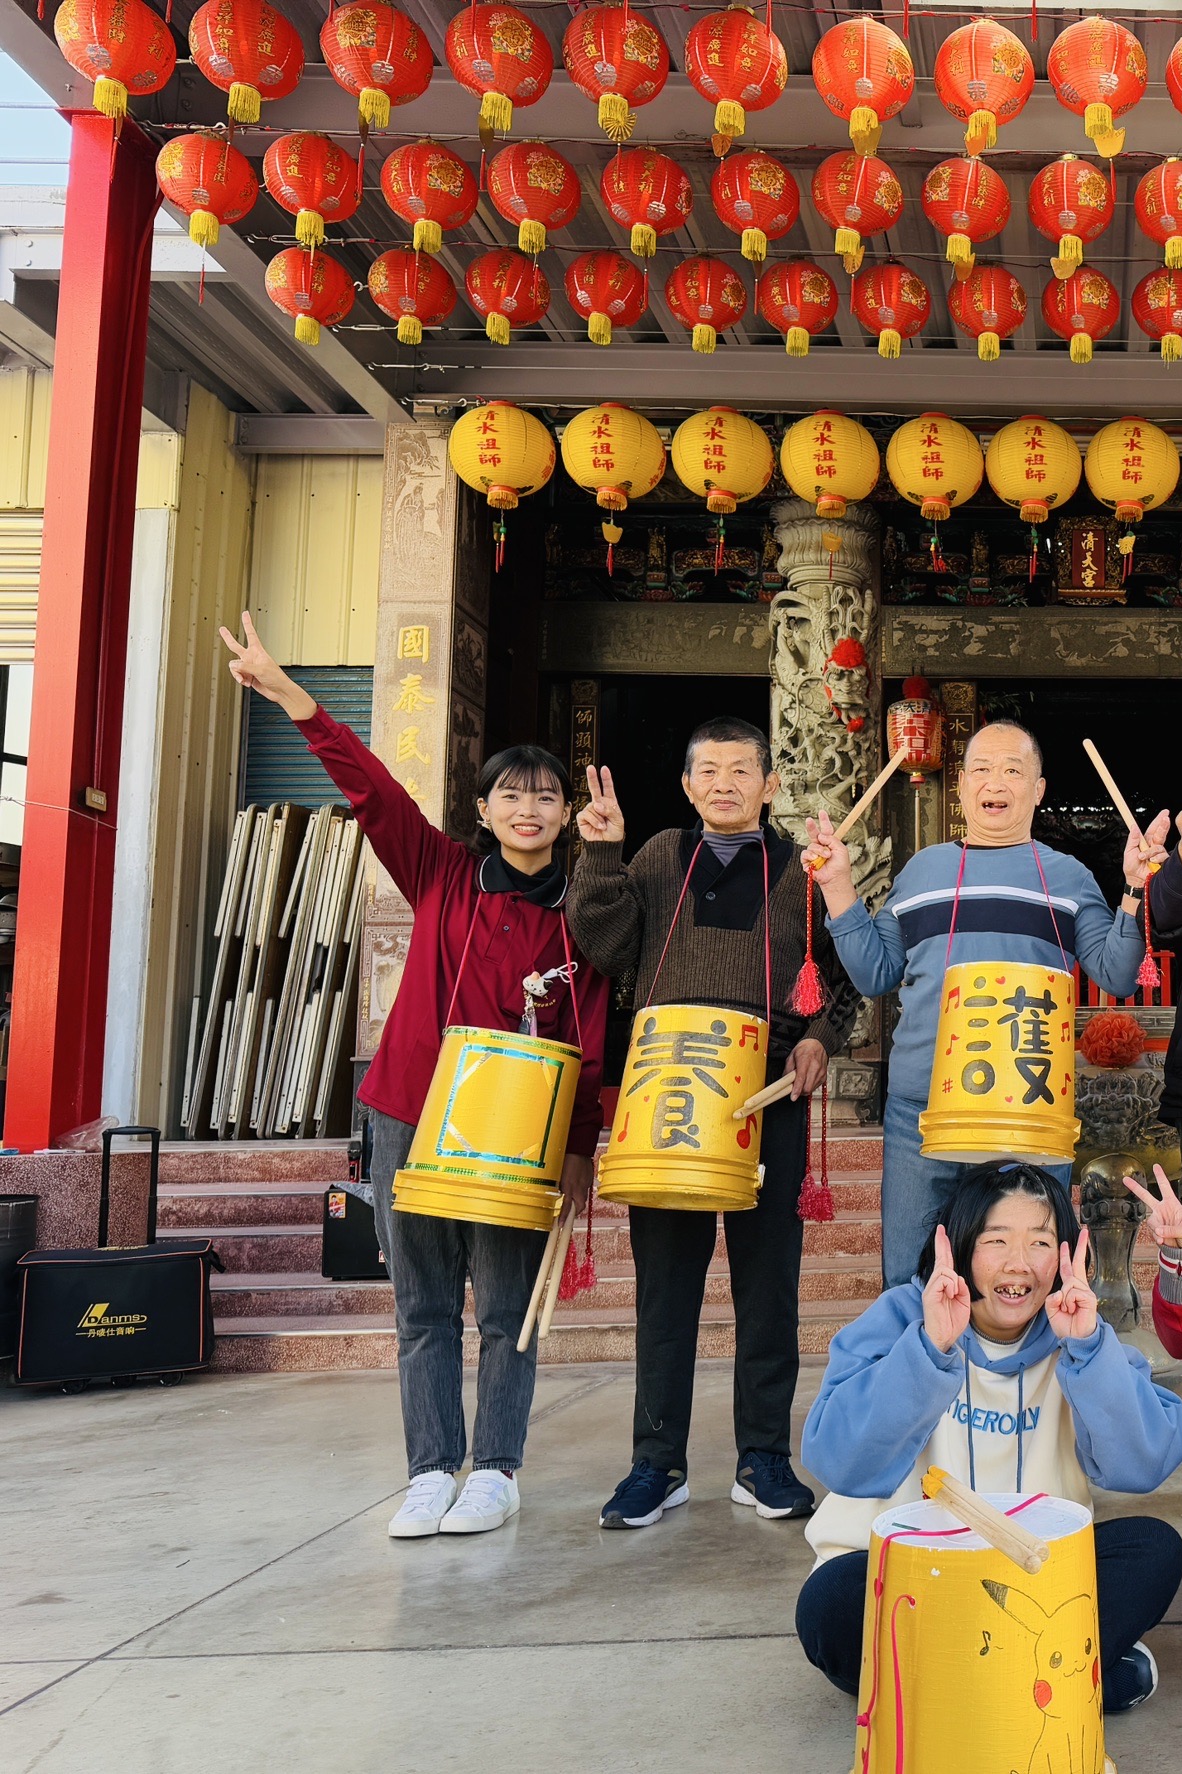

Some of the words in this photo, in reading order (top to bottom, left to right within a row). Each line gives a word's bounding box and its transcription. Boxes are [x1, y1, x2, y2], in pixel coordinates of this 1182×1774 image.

[475, 410, 502, 468] 清水祖師
[589, 413, 615, 472] 清水祖師
[702, 417, 727, 474] 清水祖師
[812, 421, 838, 478] 清水祖師
[919, 422, 945, 481] 清水祖師
[1024, 425, 1048, 483] 清水祖師
[1121, 426, 1145, 484] 清水祖師
[1081, 531, 1099, 587] 清天宮
[961, 975, 1058, 1105] 護
[625, 1016, 731, 1150] 養
